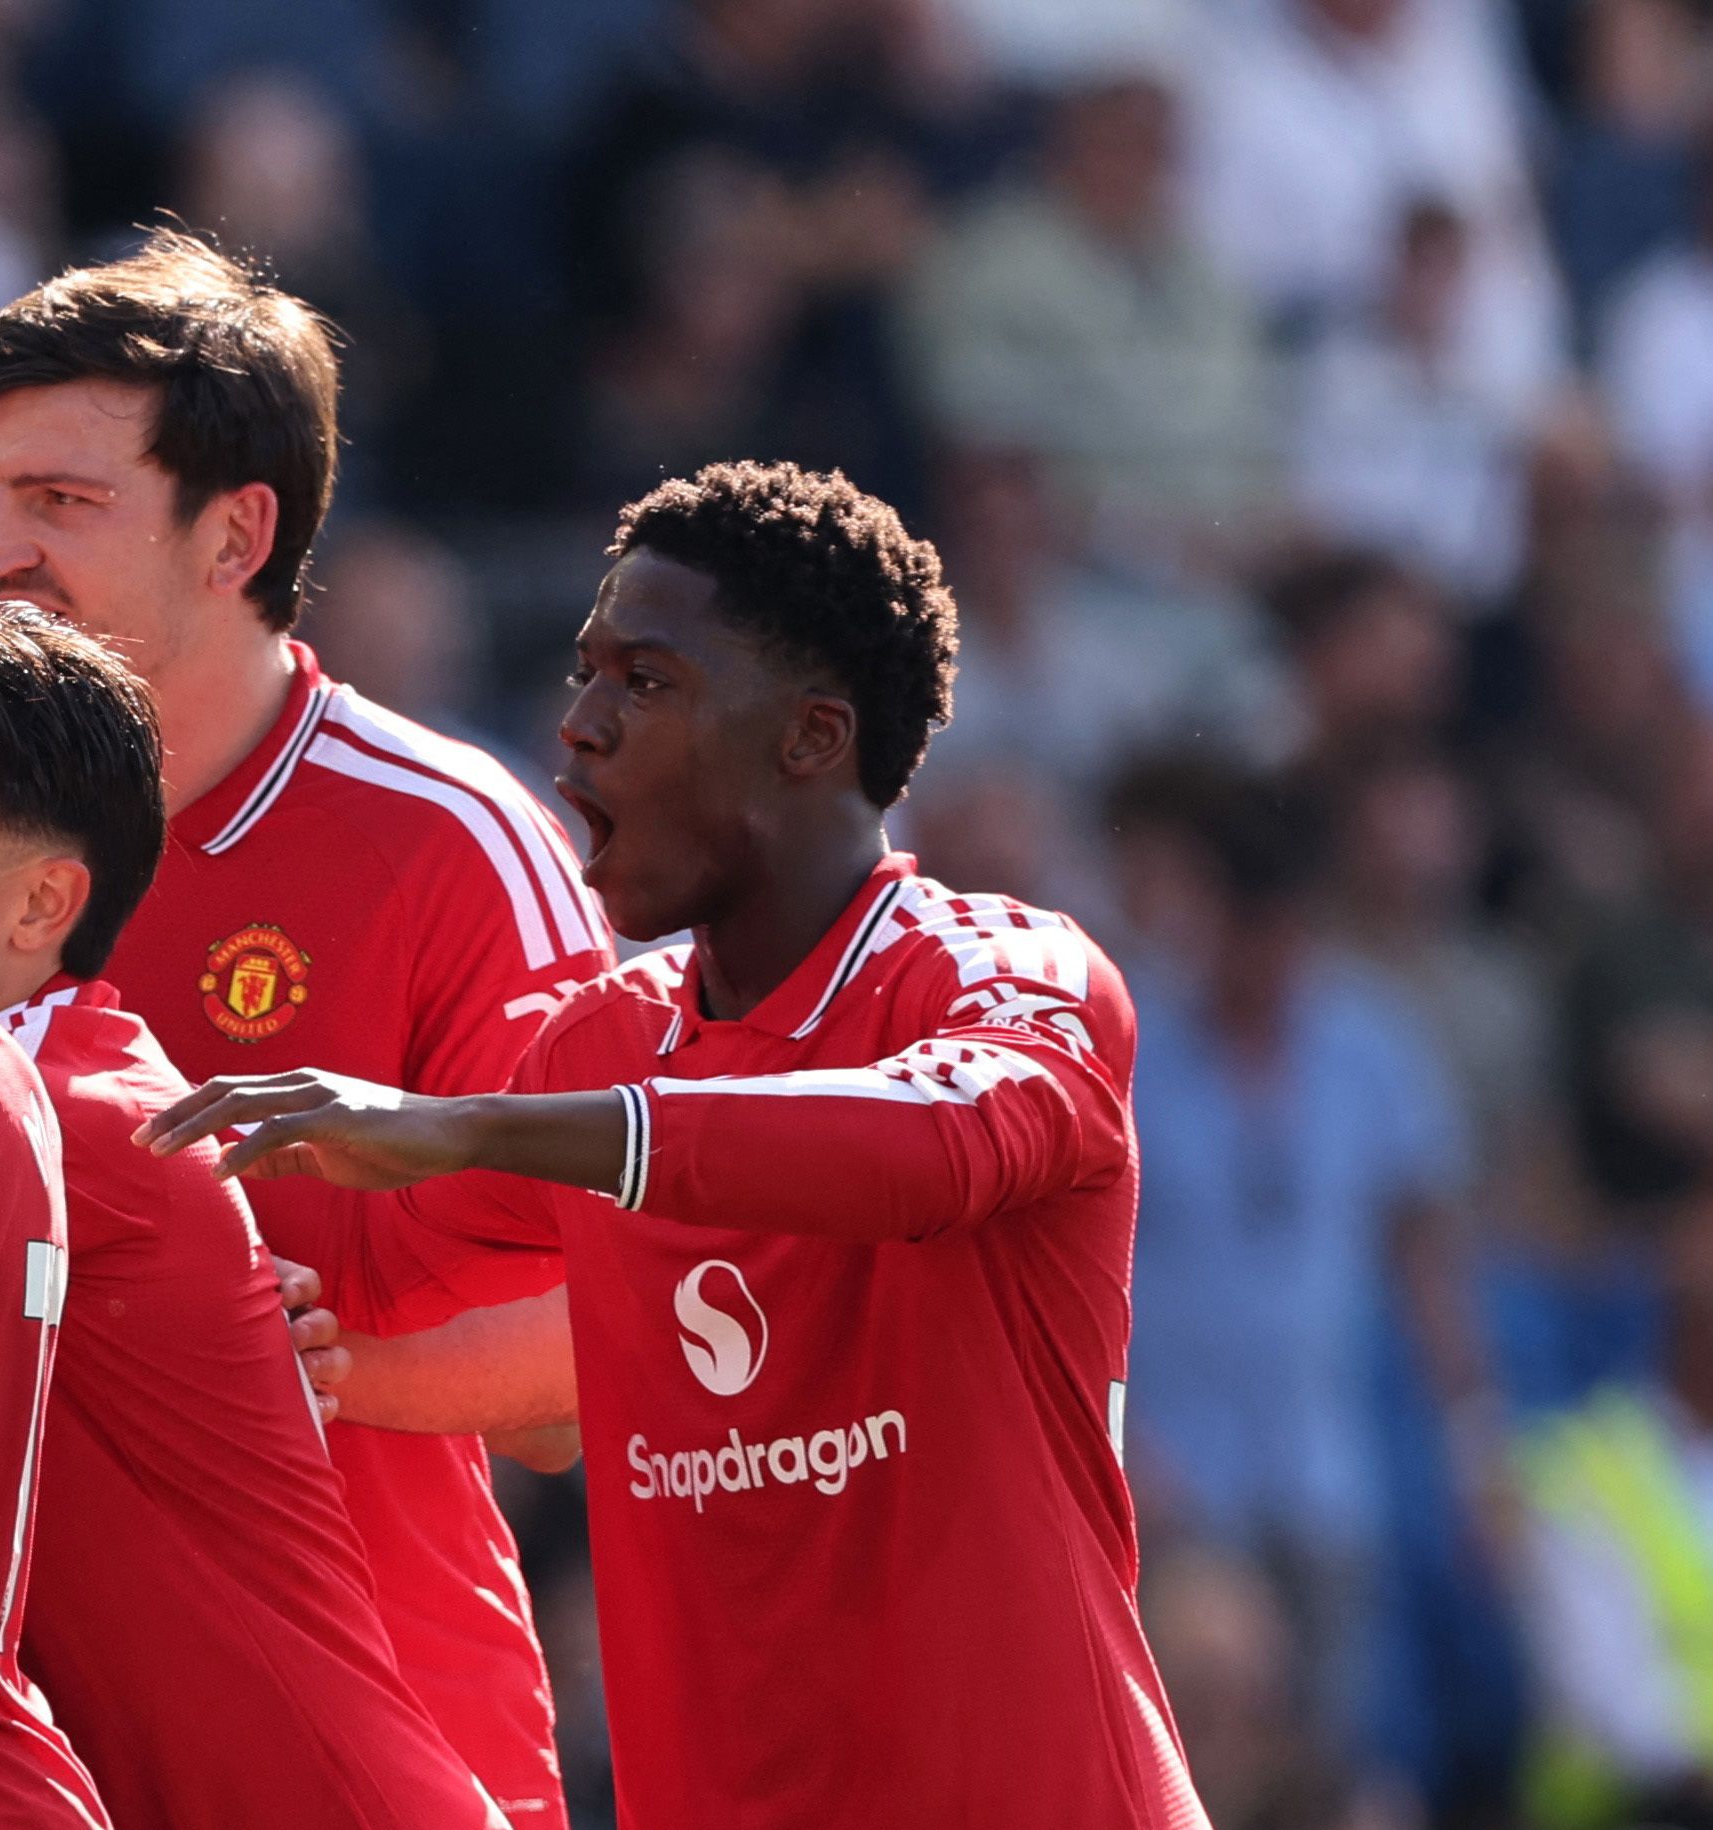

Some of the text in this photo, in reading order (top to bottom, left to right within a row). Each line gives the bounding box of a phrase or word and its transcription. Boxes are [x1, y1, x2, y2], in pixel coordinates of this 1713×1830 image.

[215, 931, 301, 972] MANCHESTER
[217, 1013, 278, 1034] UNITED
[627, 1410, 906, 1514] Snapdragon
